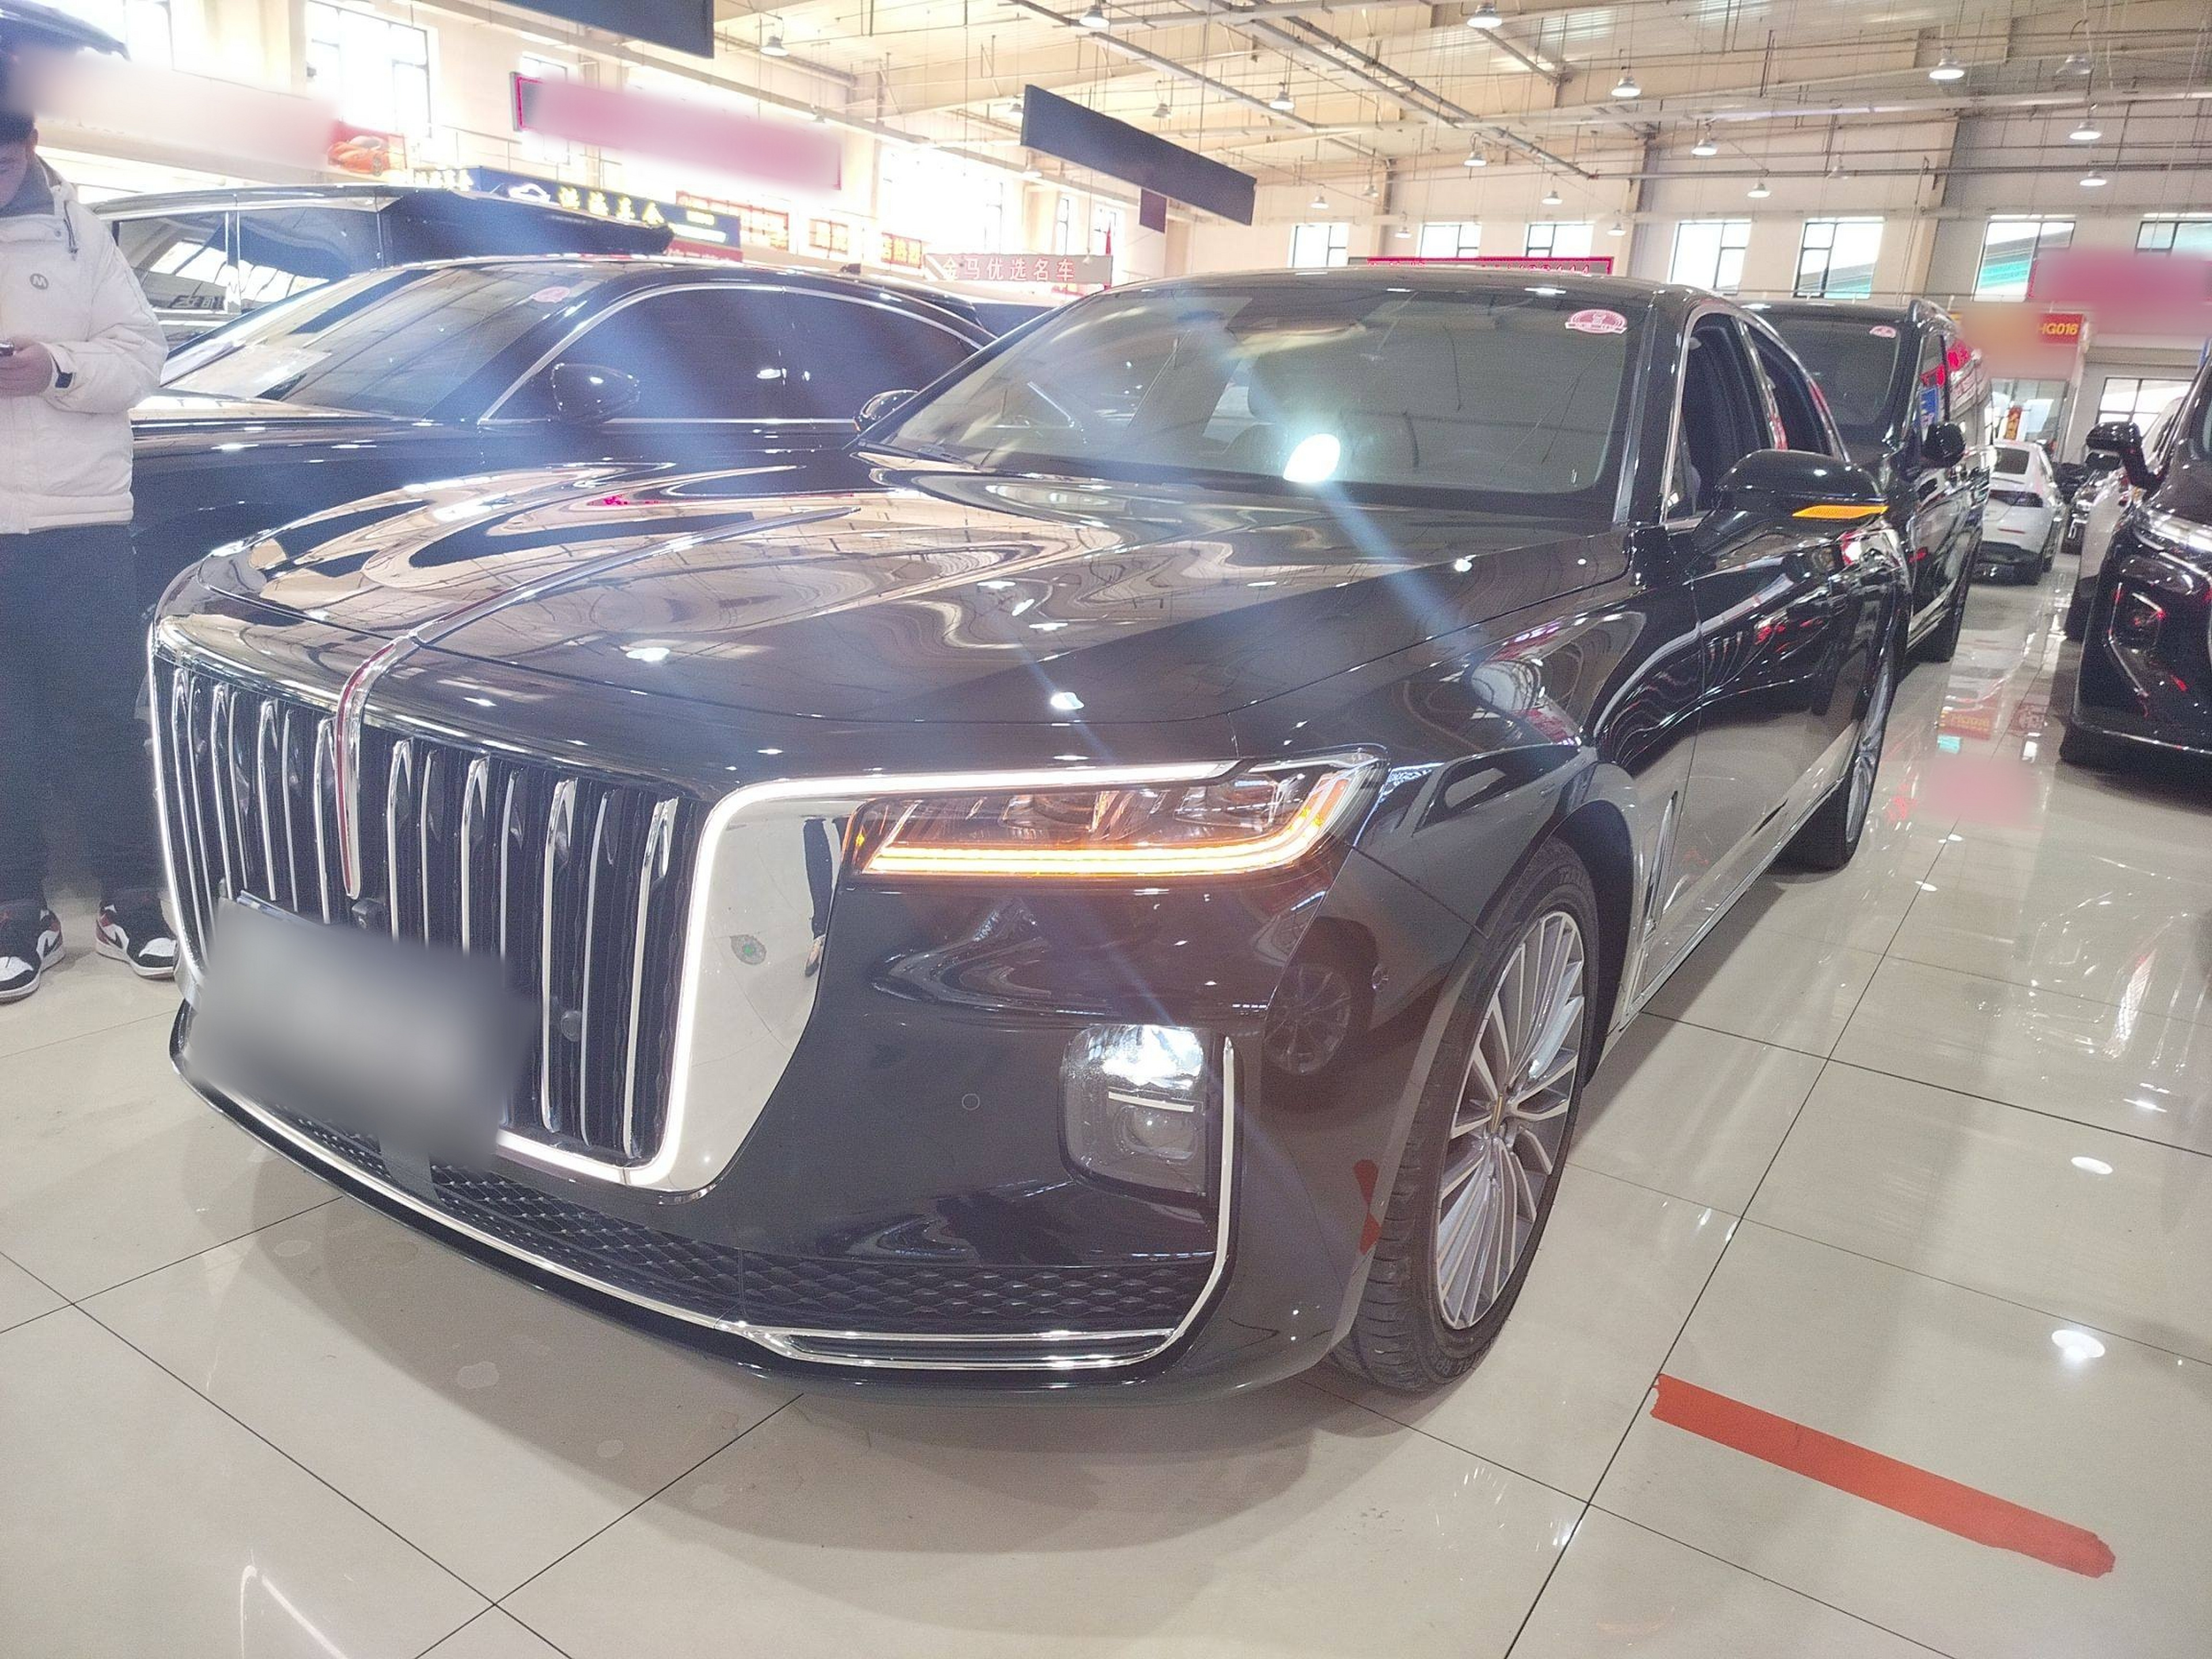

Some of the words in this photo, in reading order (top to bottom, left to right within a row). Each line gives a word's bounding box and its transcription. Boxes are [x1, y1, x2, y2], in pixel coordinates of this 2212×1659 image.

[943, 256, 1074, 282] 金马优选名车
